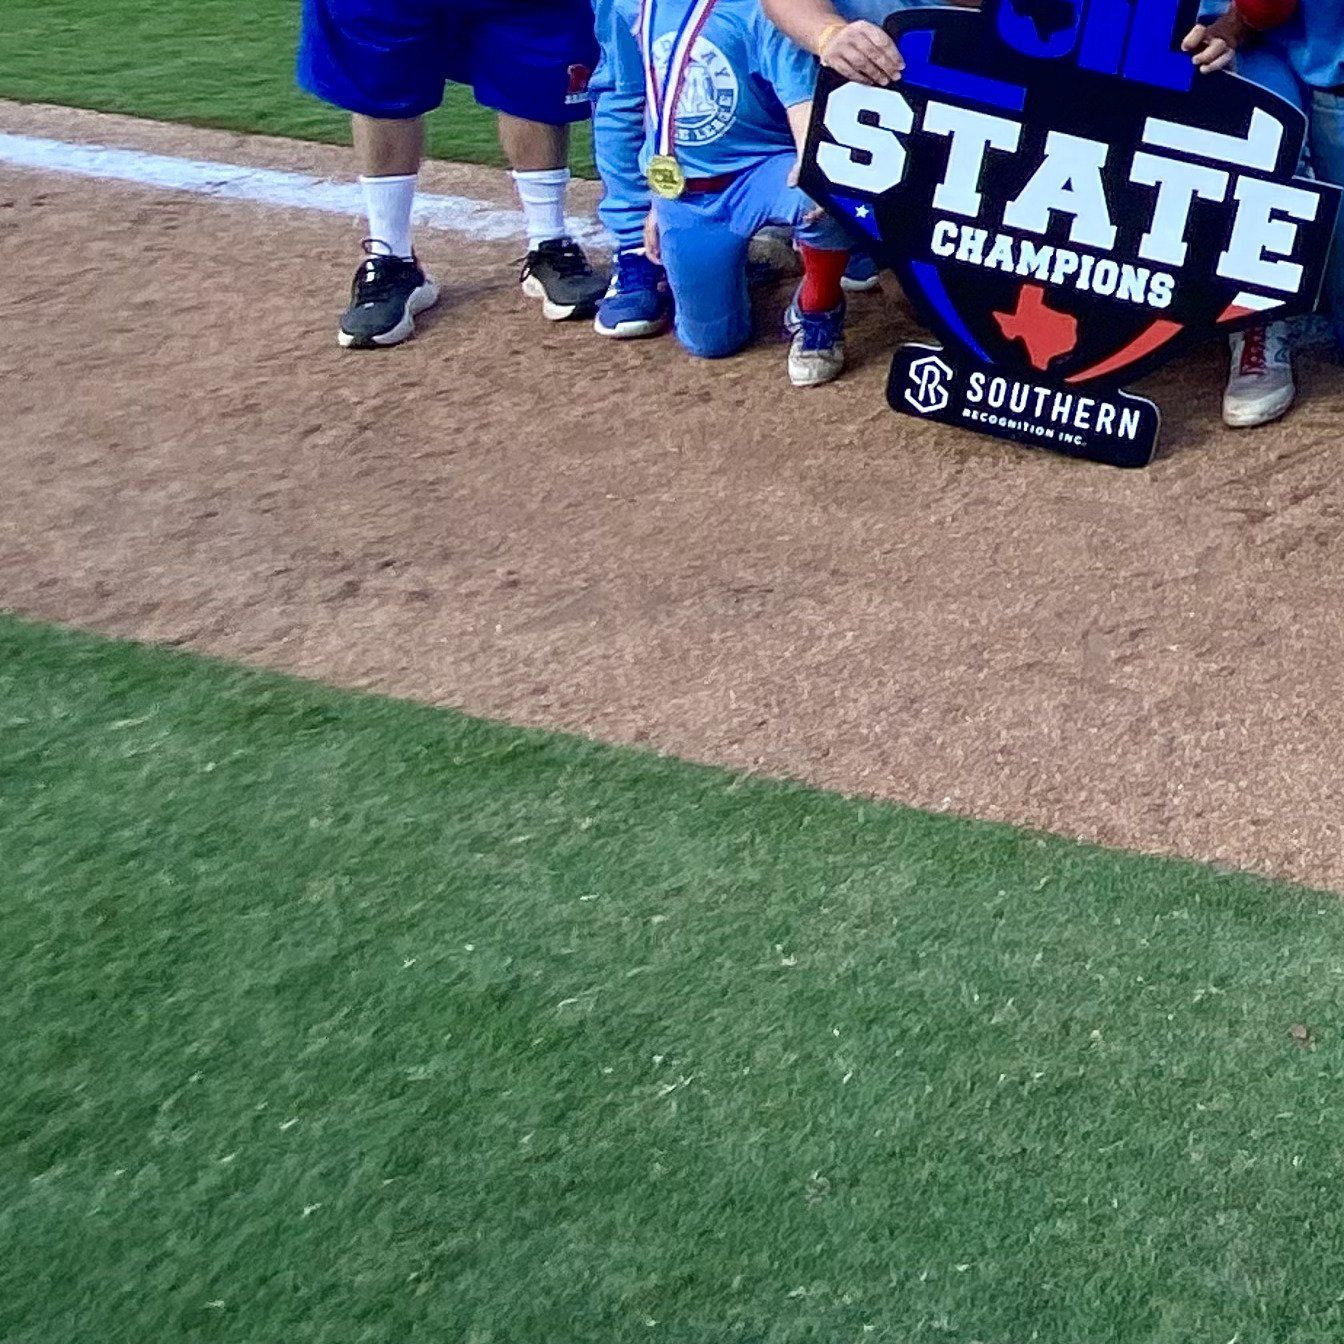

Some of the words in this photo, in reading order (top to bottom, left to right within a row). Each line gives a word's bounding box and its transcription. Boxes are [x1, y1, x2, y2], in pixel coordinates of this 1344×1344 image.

[815, 81, 1320, 294] STATE
[930, 221, 1177, 309] CHAMPIONS
[962, 408, 1055, 439] RECOGNITION
[966, 372, 1140, 440] SOUTHERN
